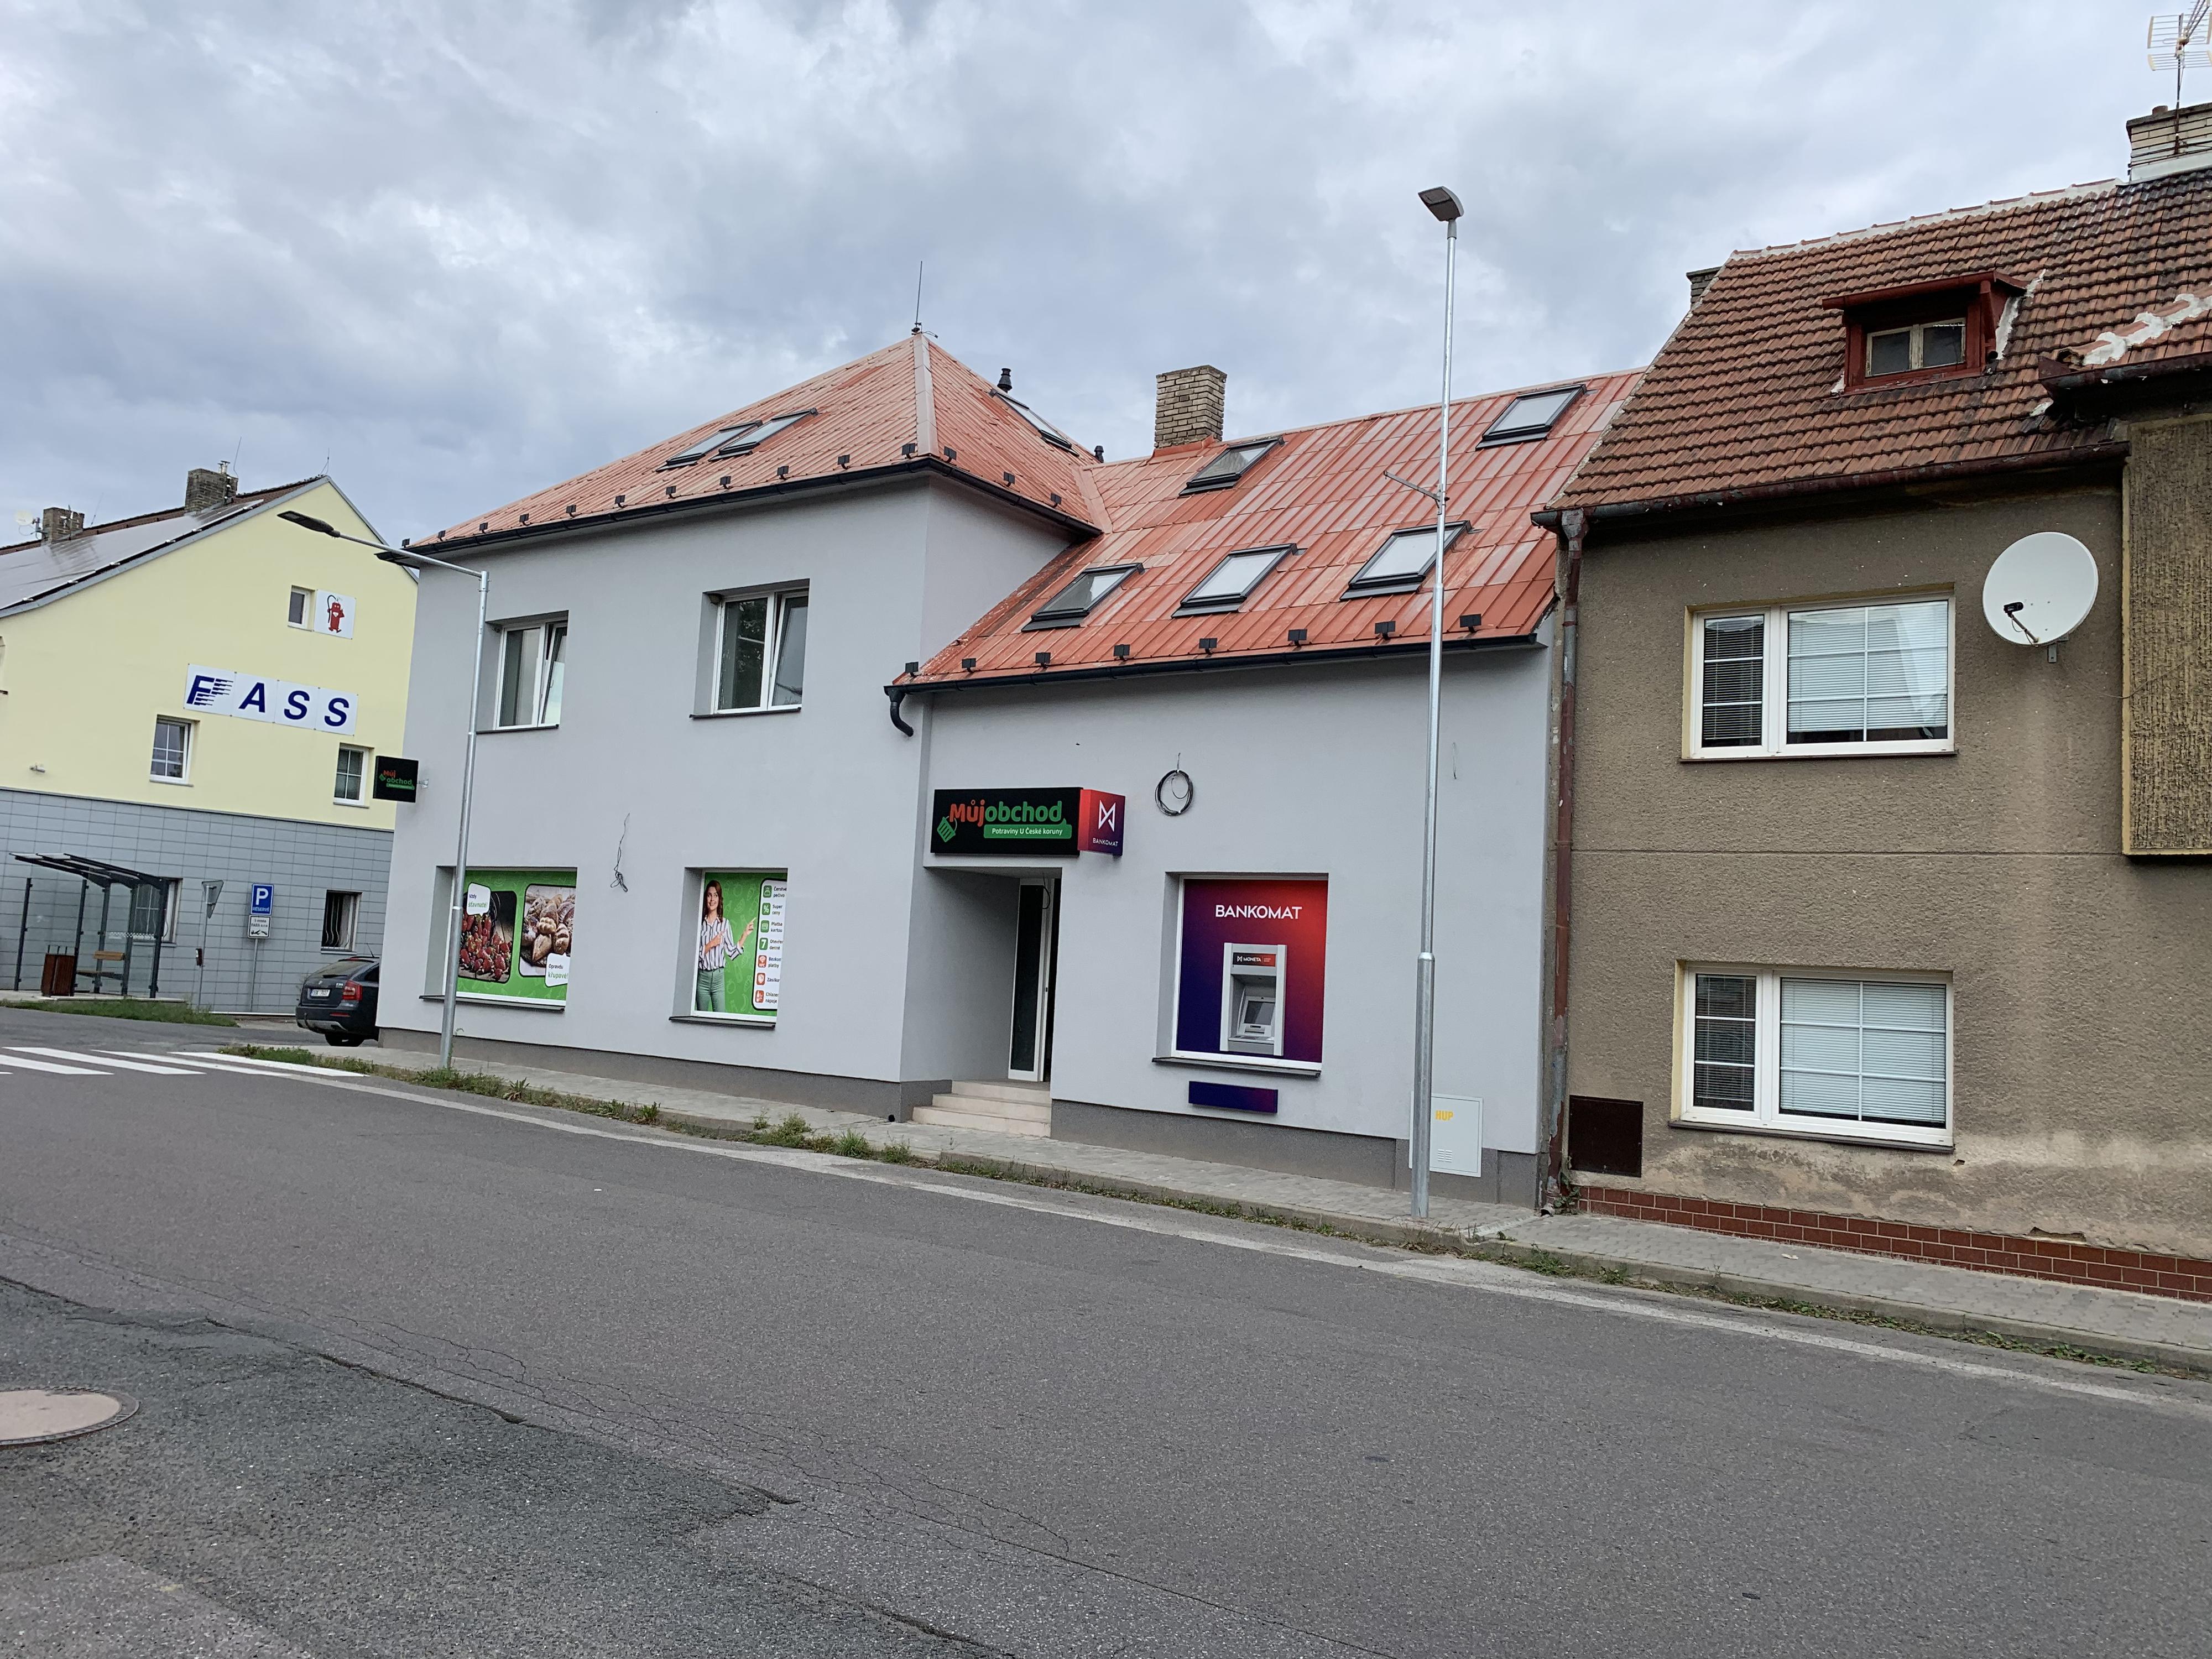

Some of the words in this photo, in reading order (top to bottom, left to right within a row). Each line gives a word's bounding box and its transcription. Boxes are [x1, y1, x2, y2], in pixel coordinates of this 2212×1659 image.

[186, 675, 349, 727] FASS
[383, 769, 396, 779] Můj
[1092, 837, 1119, 847] BANKOMAT
[255, 888, 269, 905] P
[1215, 904, 1303, 920] BANKOMAT
[1435, 1110, 1453, 1121] HUP
